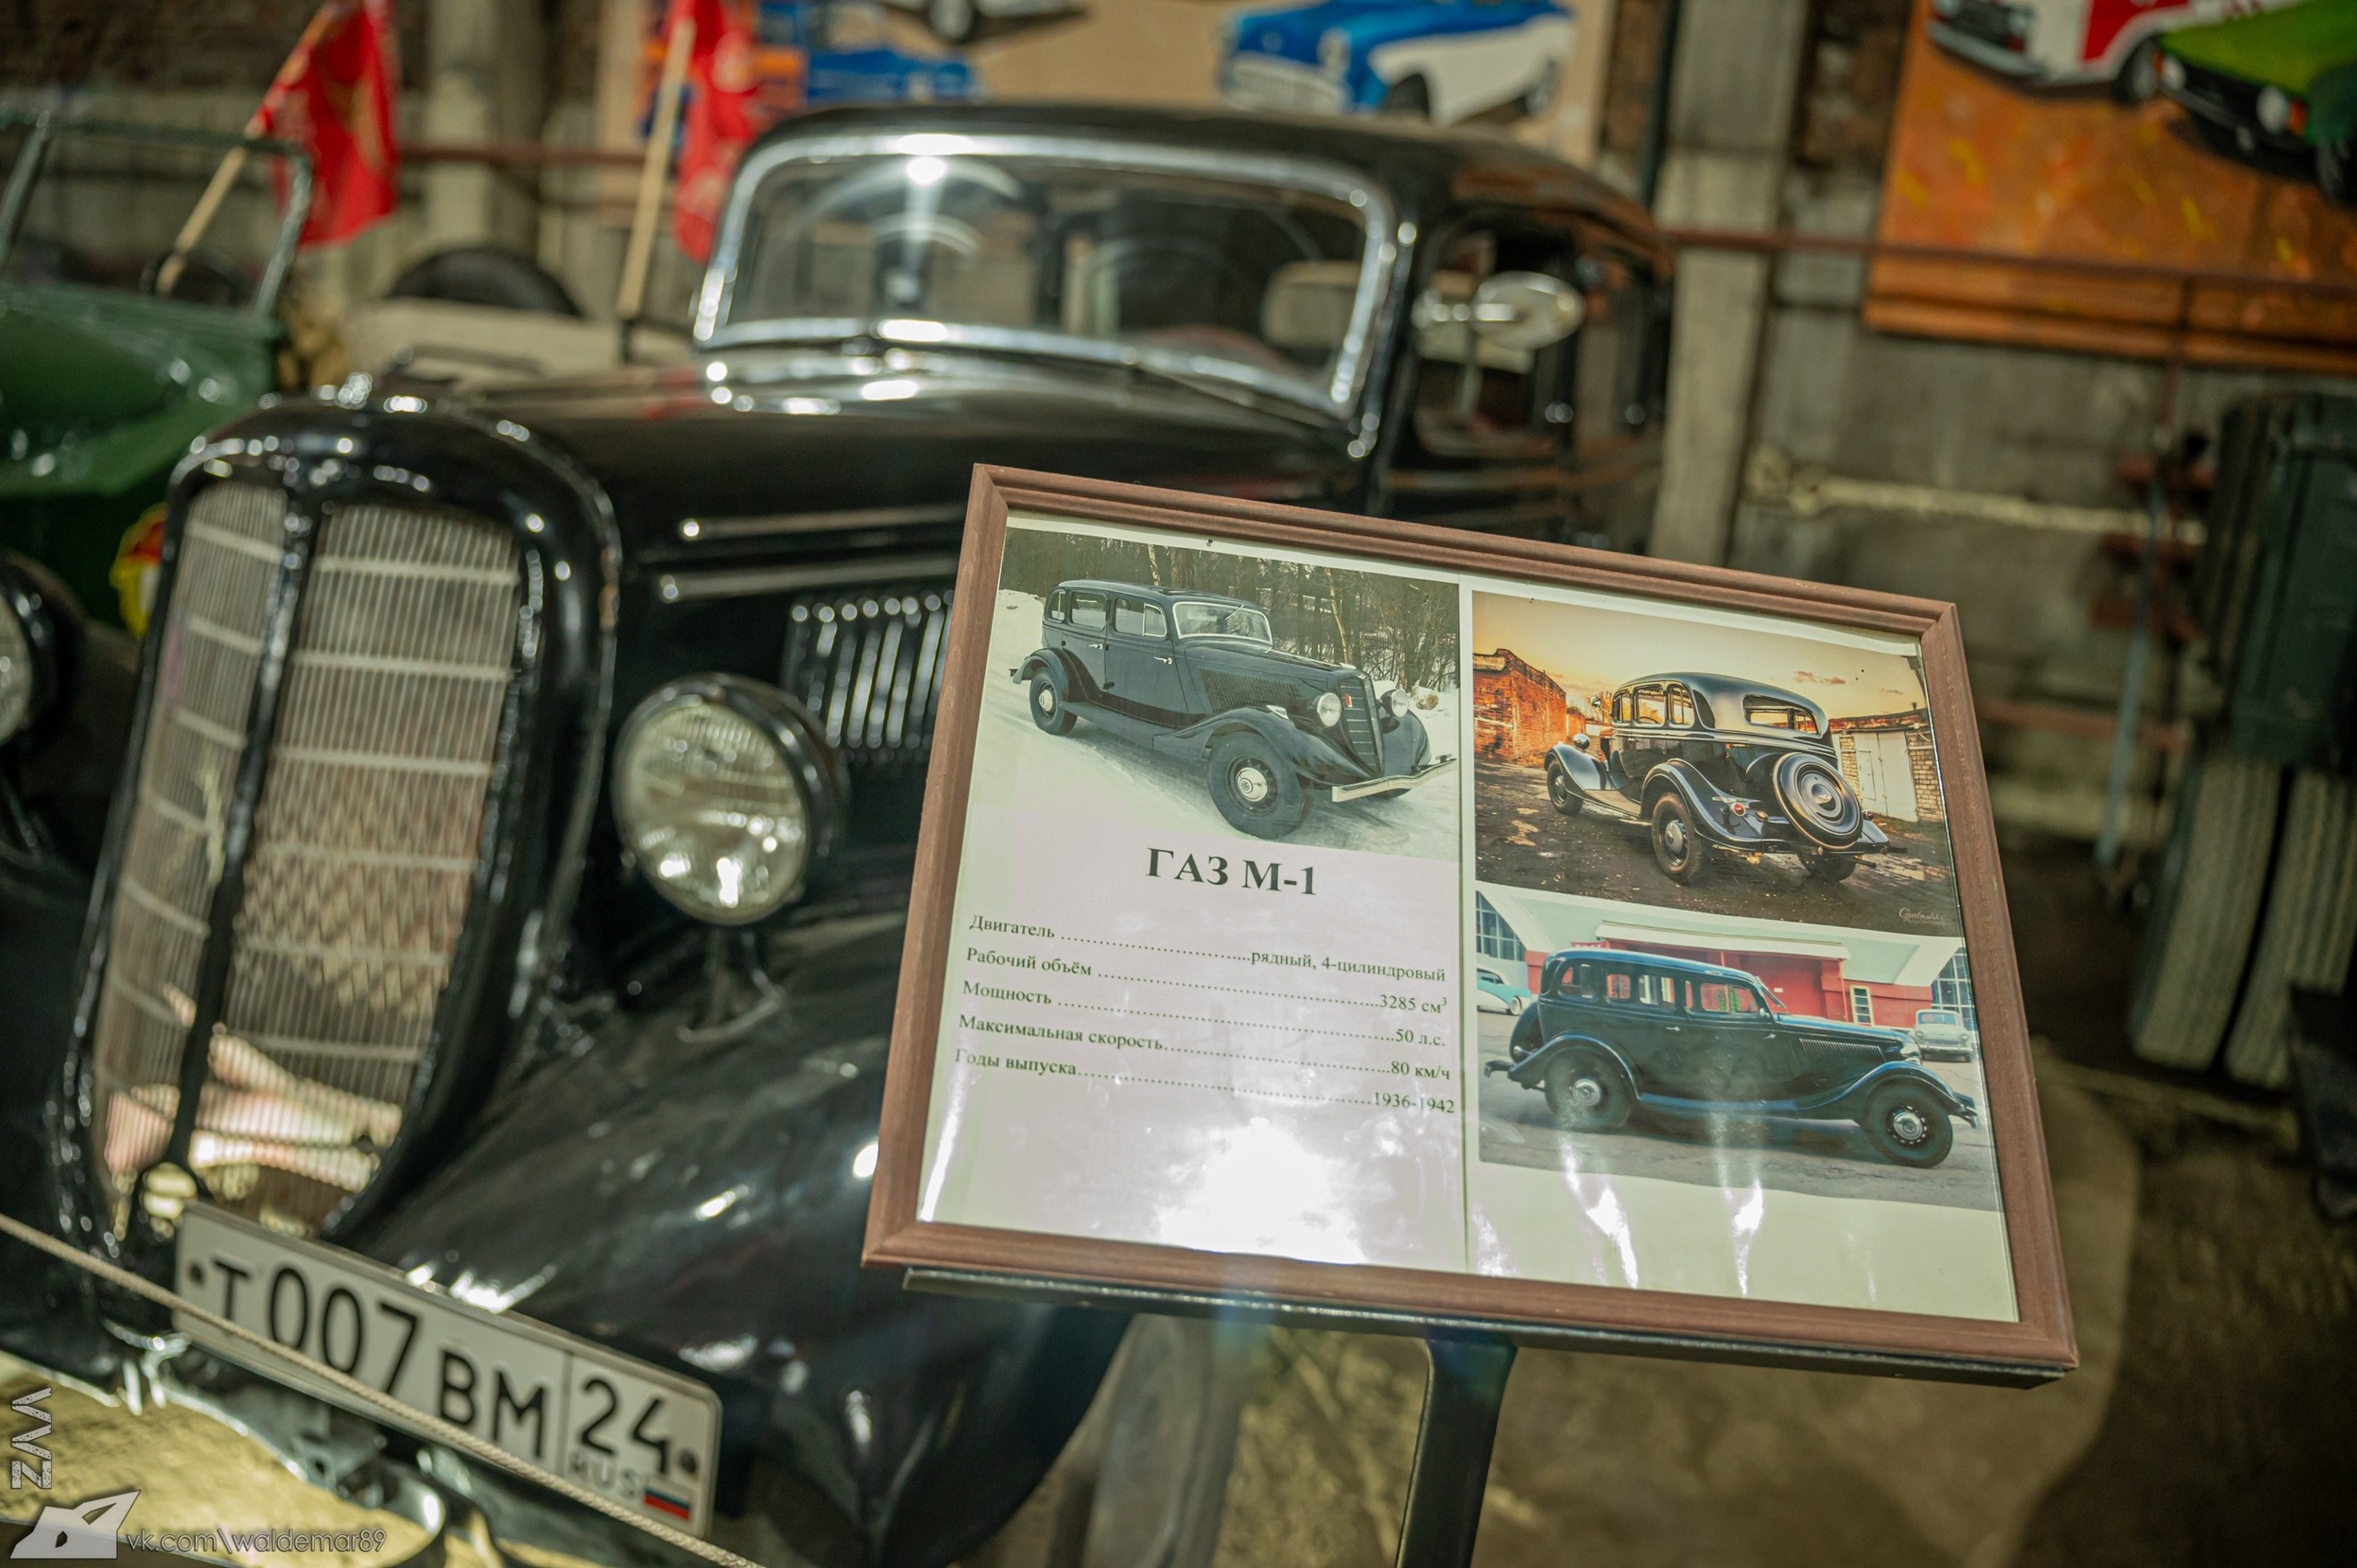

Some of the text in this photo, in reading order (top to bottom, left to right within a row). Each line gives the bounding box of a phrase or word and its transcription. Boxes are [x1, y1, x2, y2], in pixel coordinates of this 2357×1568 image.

[1145, 848, 1317, 896] ГАЗ М-1
[966, 947, 1037, 970] Рабочий
[1041, 958, 1093, 976] объём
[1379, 994, 1416, 1011] 3285
[969, 914, 1446, 981] Двигатель рядный, 4-цилиндровый
[962, 980, 1446, 1047] Мощность 50 л.с.
[958, 1014, 1451, 1080] Максимальная скорость 80 км/ч
[955, 1048, 1456, 1113] Годы выпуска 1936-1942
[581, 1378, 670, 1474] 24
